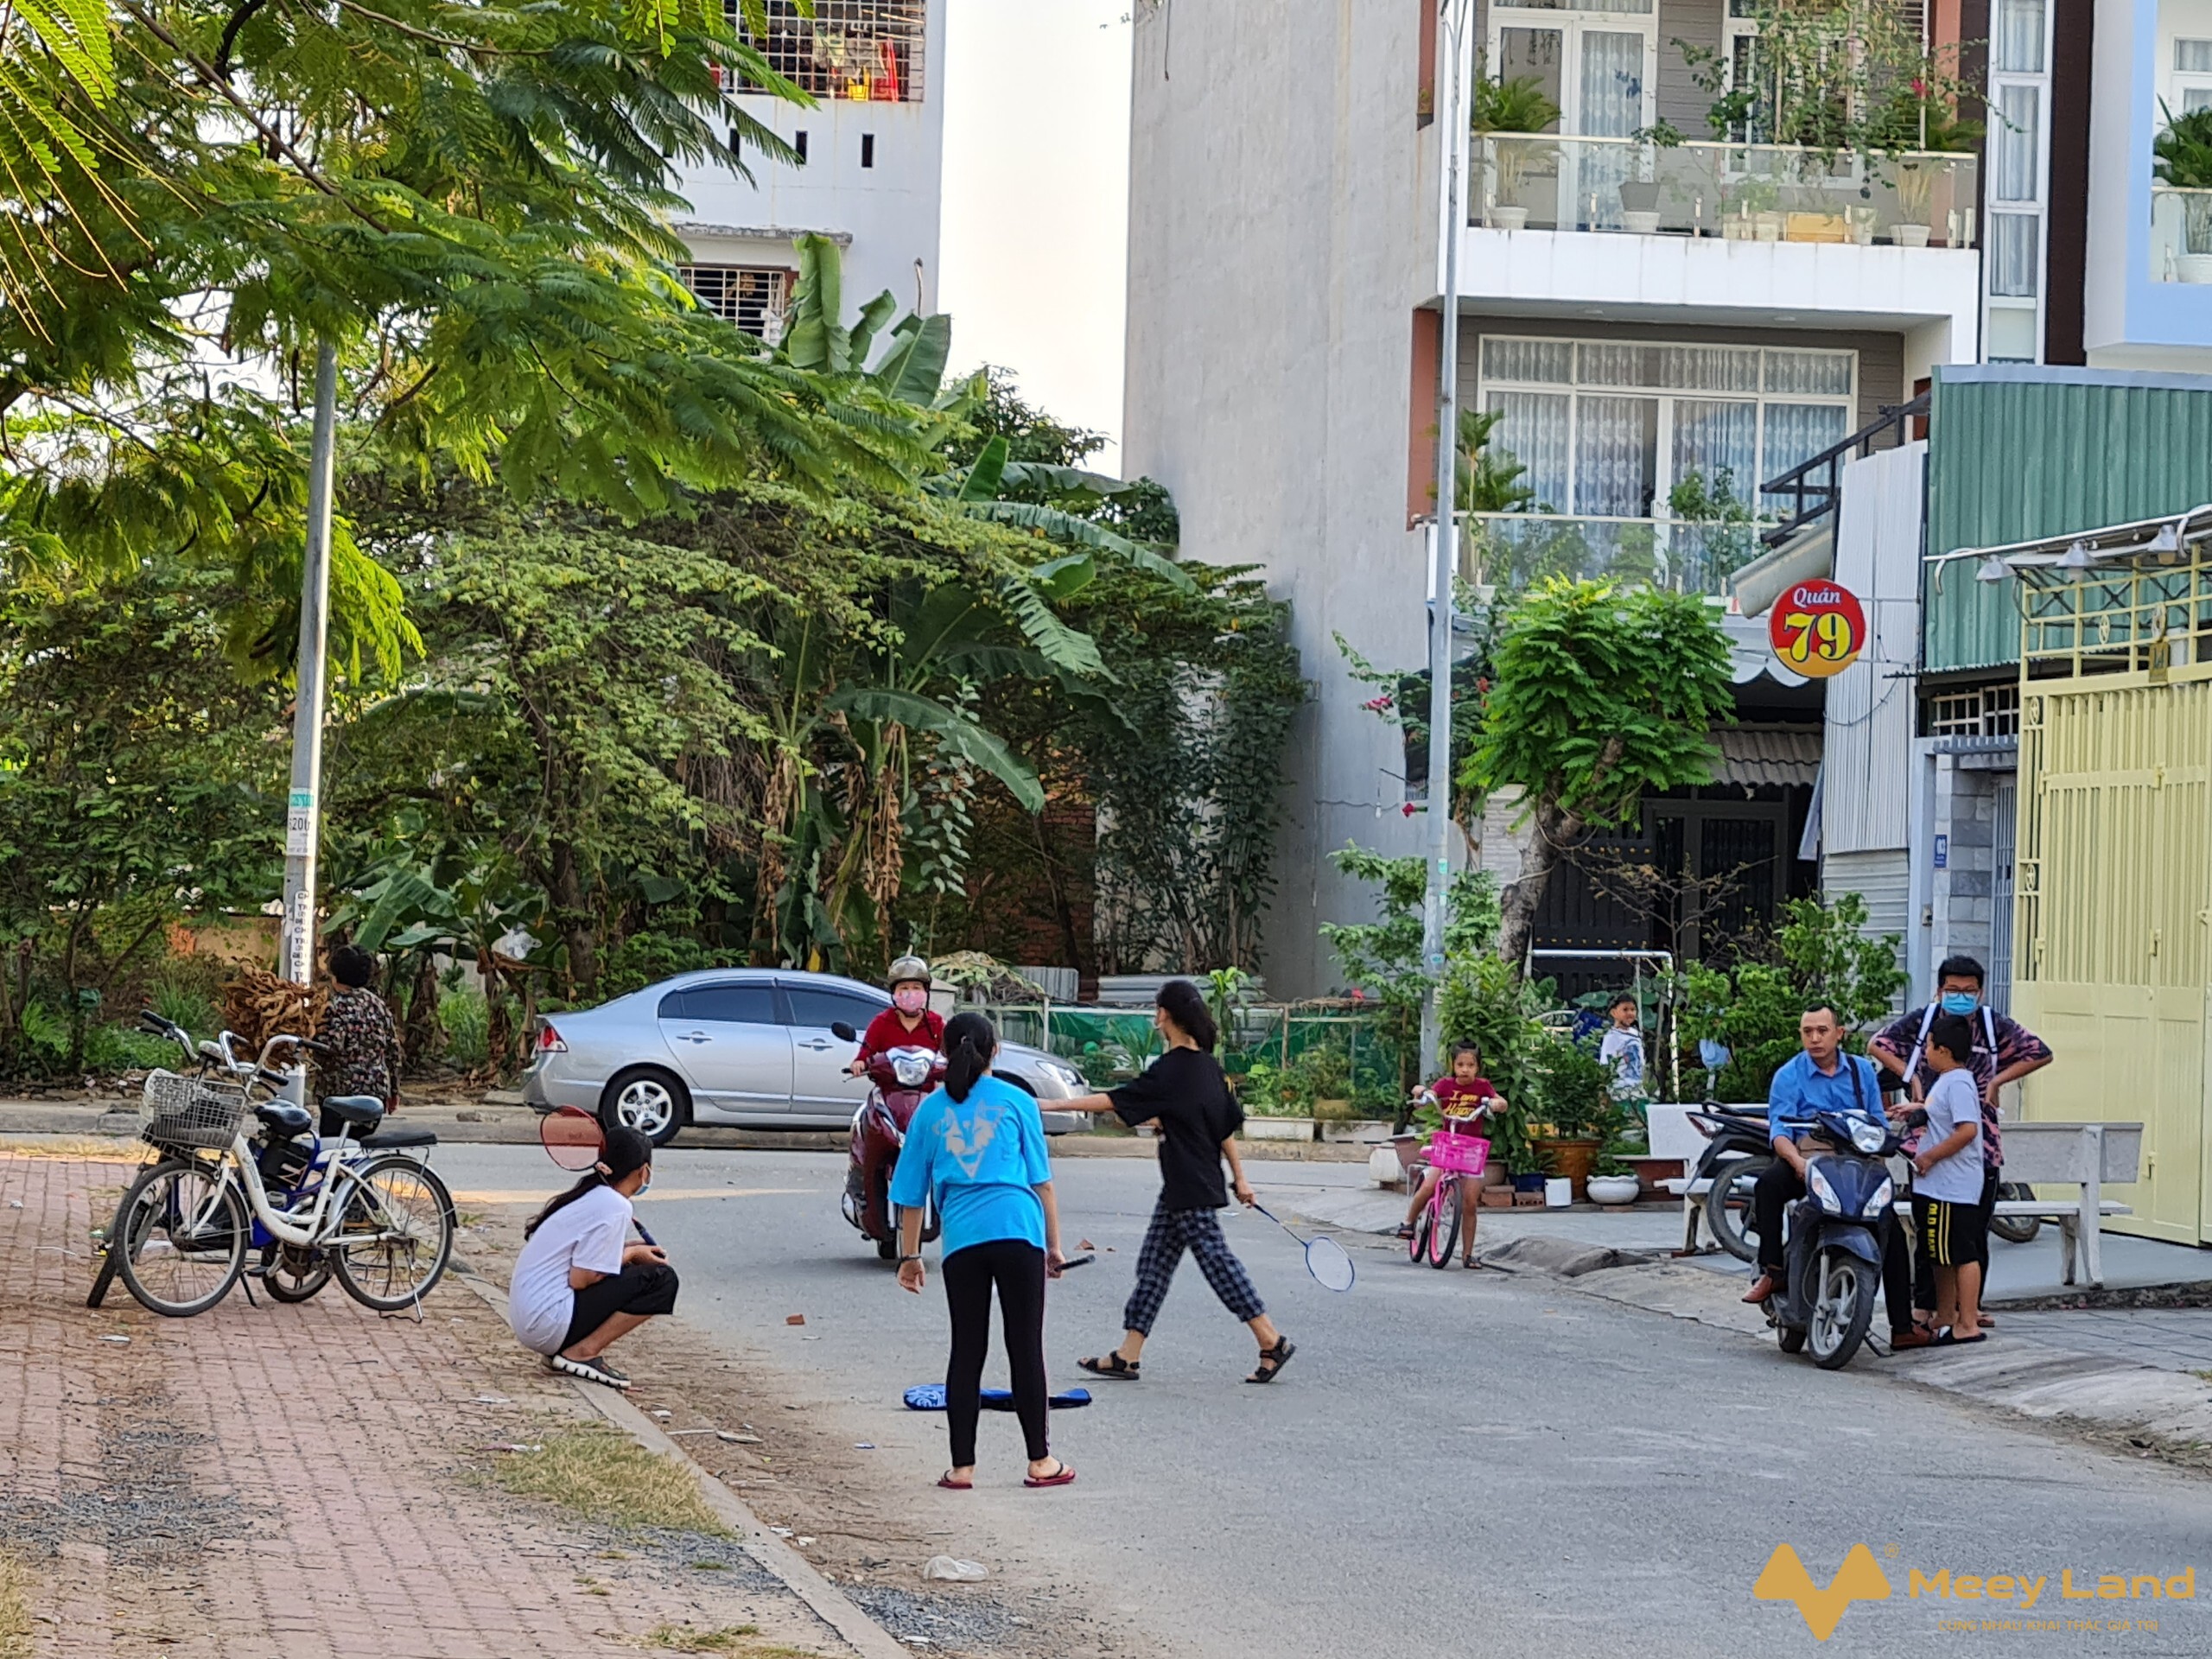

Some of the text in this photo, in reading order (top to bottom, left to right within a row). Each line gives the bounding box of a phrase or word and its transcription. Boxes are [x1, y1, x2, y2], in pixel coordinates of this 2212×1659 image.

[1794, 588, 1841, 607] Quán
[1783, 612, 1853, 662] 79
[1449, 1090, 1462, 1101] I
[1928, 1203, 1938, 1258] OLD NAVY
